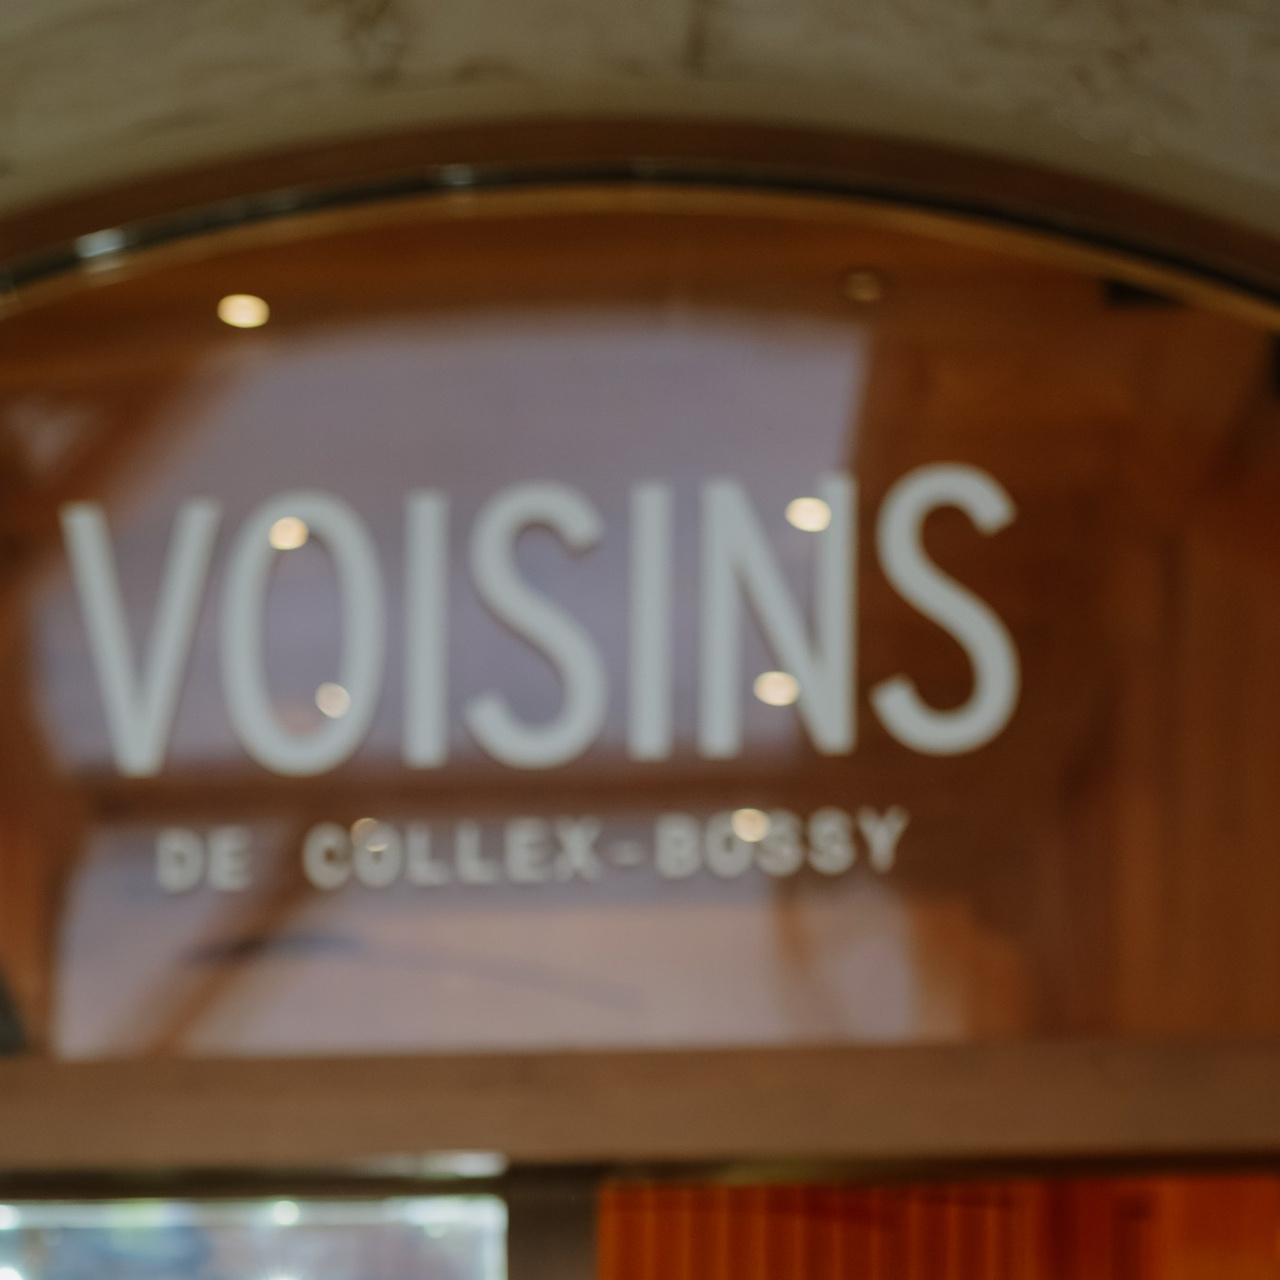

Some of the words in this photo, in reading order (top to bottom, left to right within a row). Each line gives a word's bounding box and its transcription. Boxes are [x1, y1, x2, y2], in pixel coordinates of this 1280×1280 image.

[59, 462, 1021, 777] VOISINS
[156, 826, 253, 893] DE
[303, 805, 909, 889] COLLEX-BOSSY
